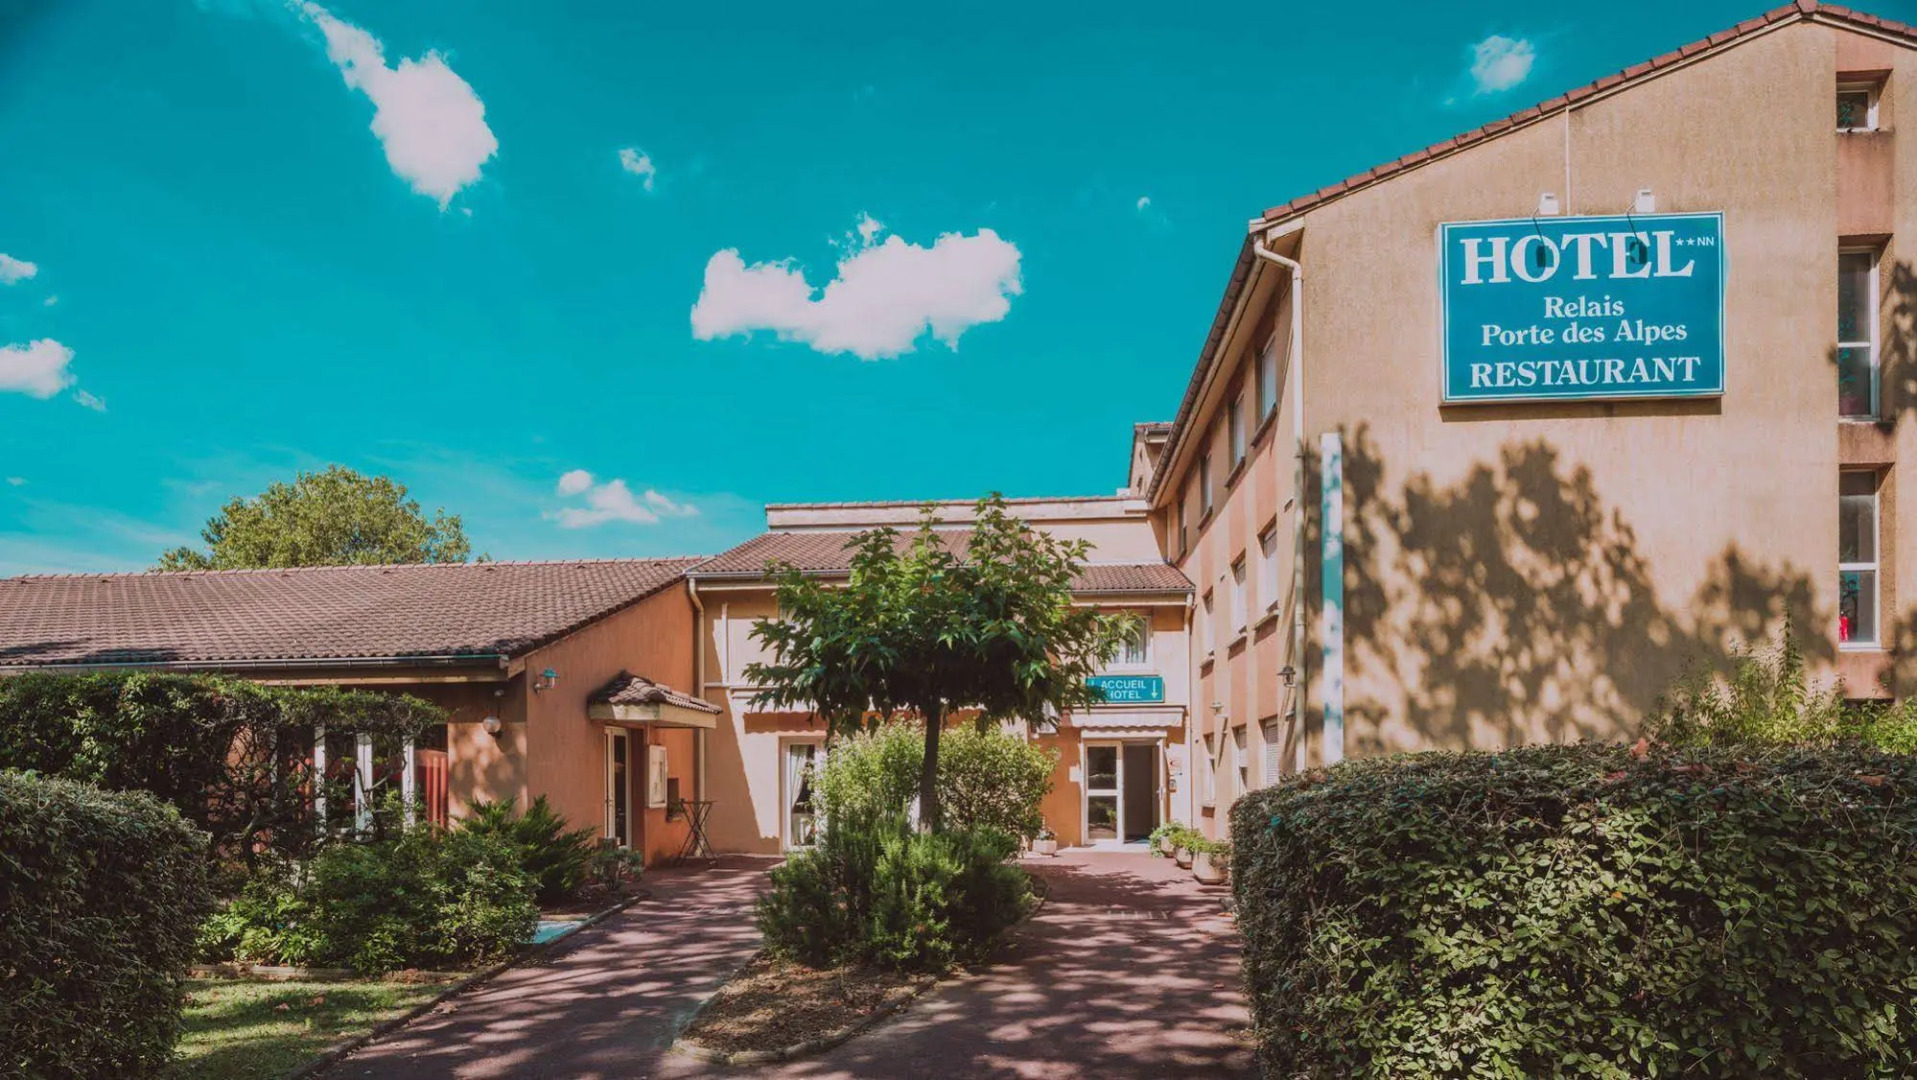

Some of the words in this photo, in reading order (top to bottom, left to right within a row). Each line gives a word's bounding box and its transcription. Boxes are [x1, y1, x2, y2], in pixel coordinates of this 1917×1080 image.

[1460, 230, 1695, 285] HOTEL
[1544, 294, 1625, 319] Relais
[1481, 323, 1555, 346] Porte
[1562, 321, 1606, 343] des
[1614, 319, 1688, 346] Alpes
[1469, 356, 1701, 388] RESTAURANT
[1101, 680, 1146, 689] ACCUEIL
